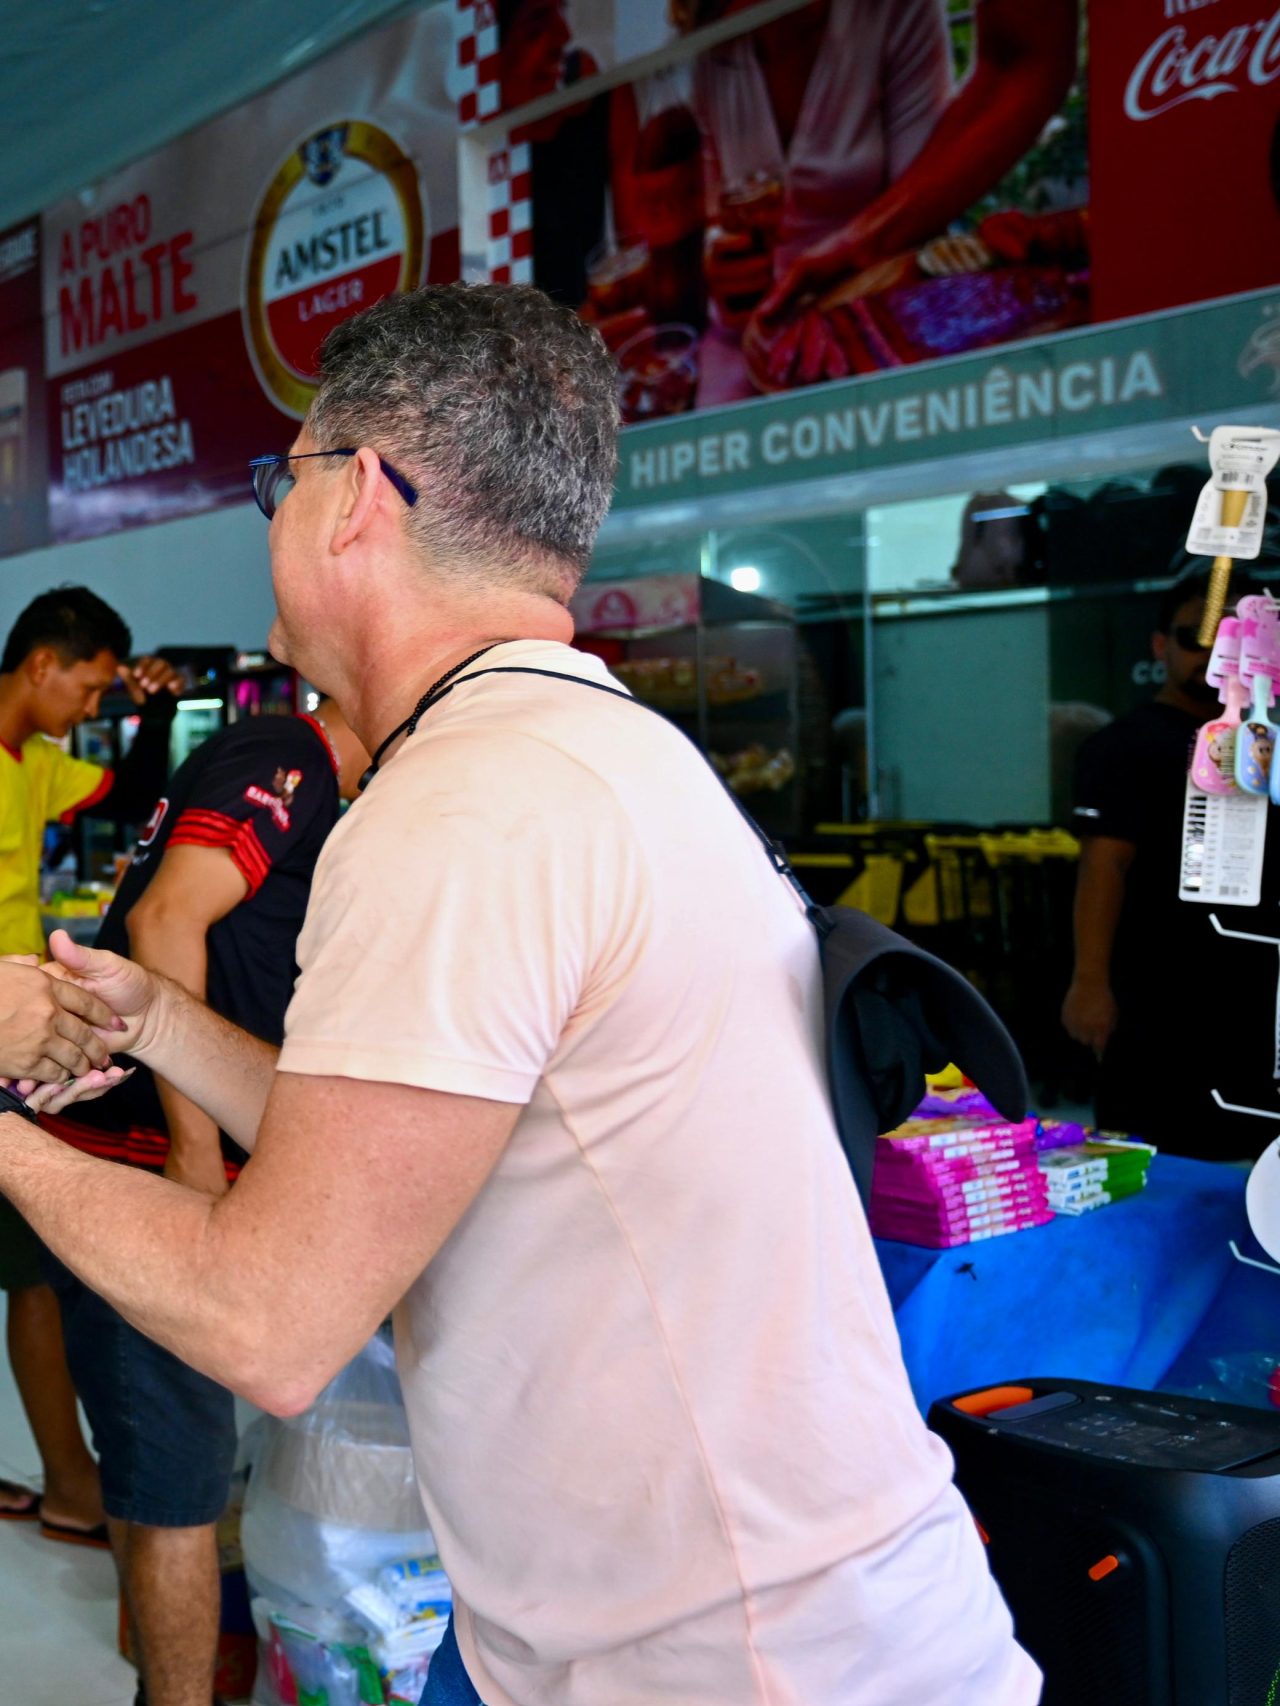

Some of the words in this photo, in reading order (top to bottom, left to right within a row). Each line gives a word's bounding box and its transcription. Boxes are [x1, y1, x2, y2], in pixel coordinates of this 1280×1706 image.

[1123, 8, 1280, 121] Coca-C
[59, 229, 76, 277] A
[81, 193, 152, 270] PURO
[275, 208, 391, 290] AMSTEL
[60, 230, 199, 359] MALTE
[298, 277, 365, 322] LAGER
[61, 375, 175, 449] LEVEDURA
[630, 431, 751, 489] HIPER
[761, 350, 1161, 464] CONVENIÊNCIA
[63, 419, 194, 495] HOLANDESA
